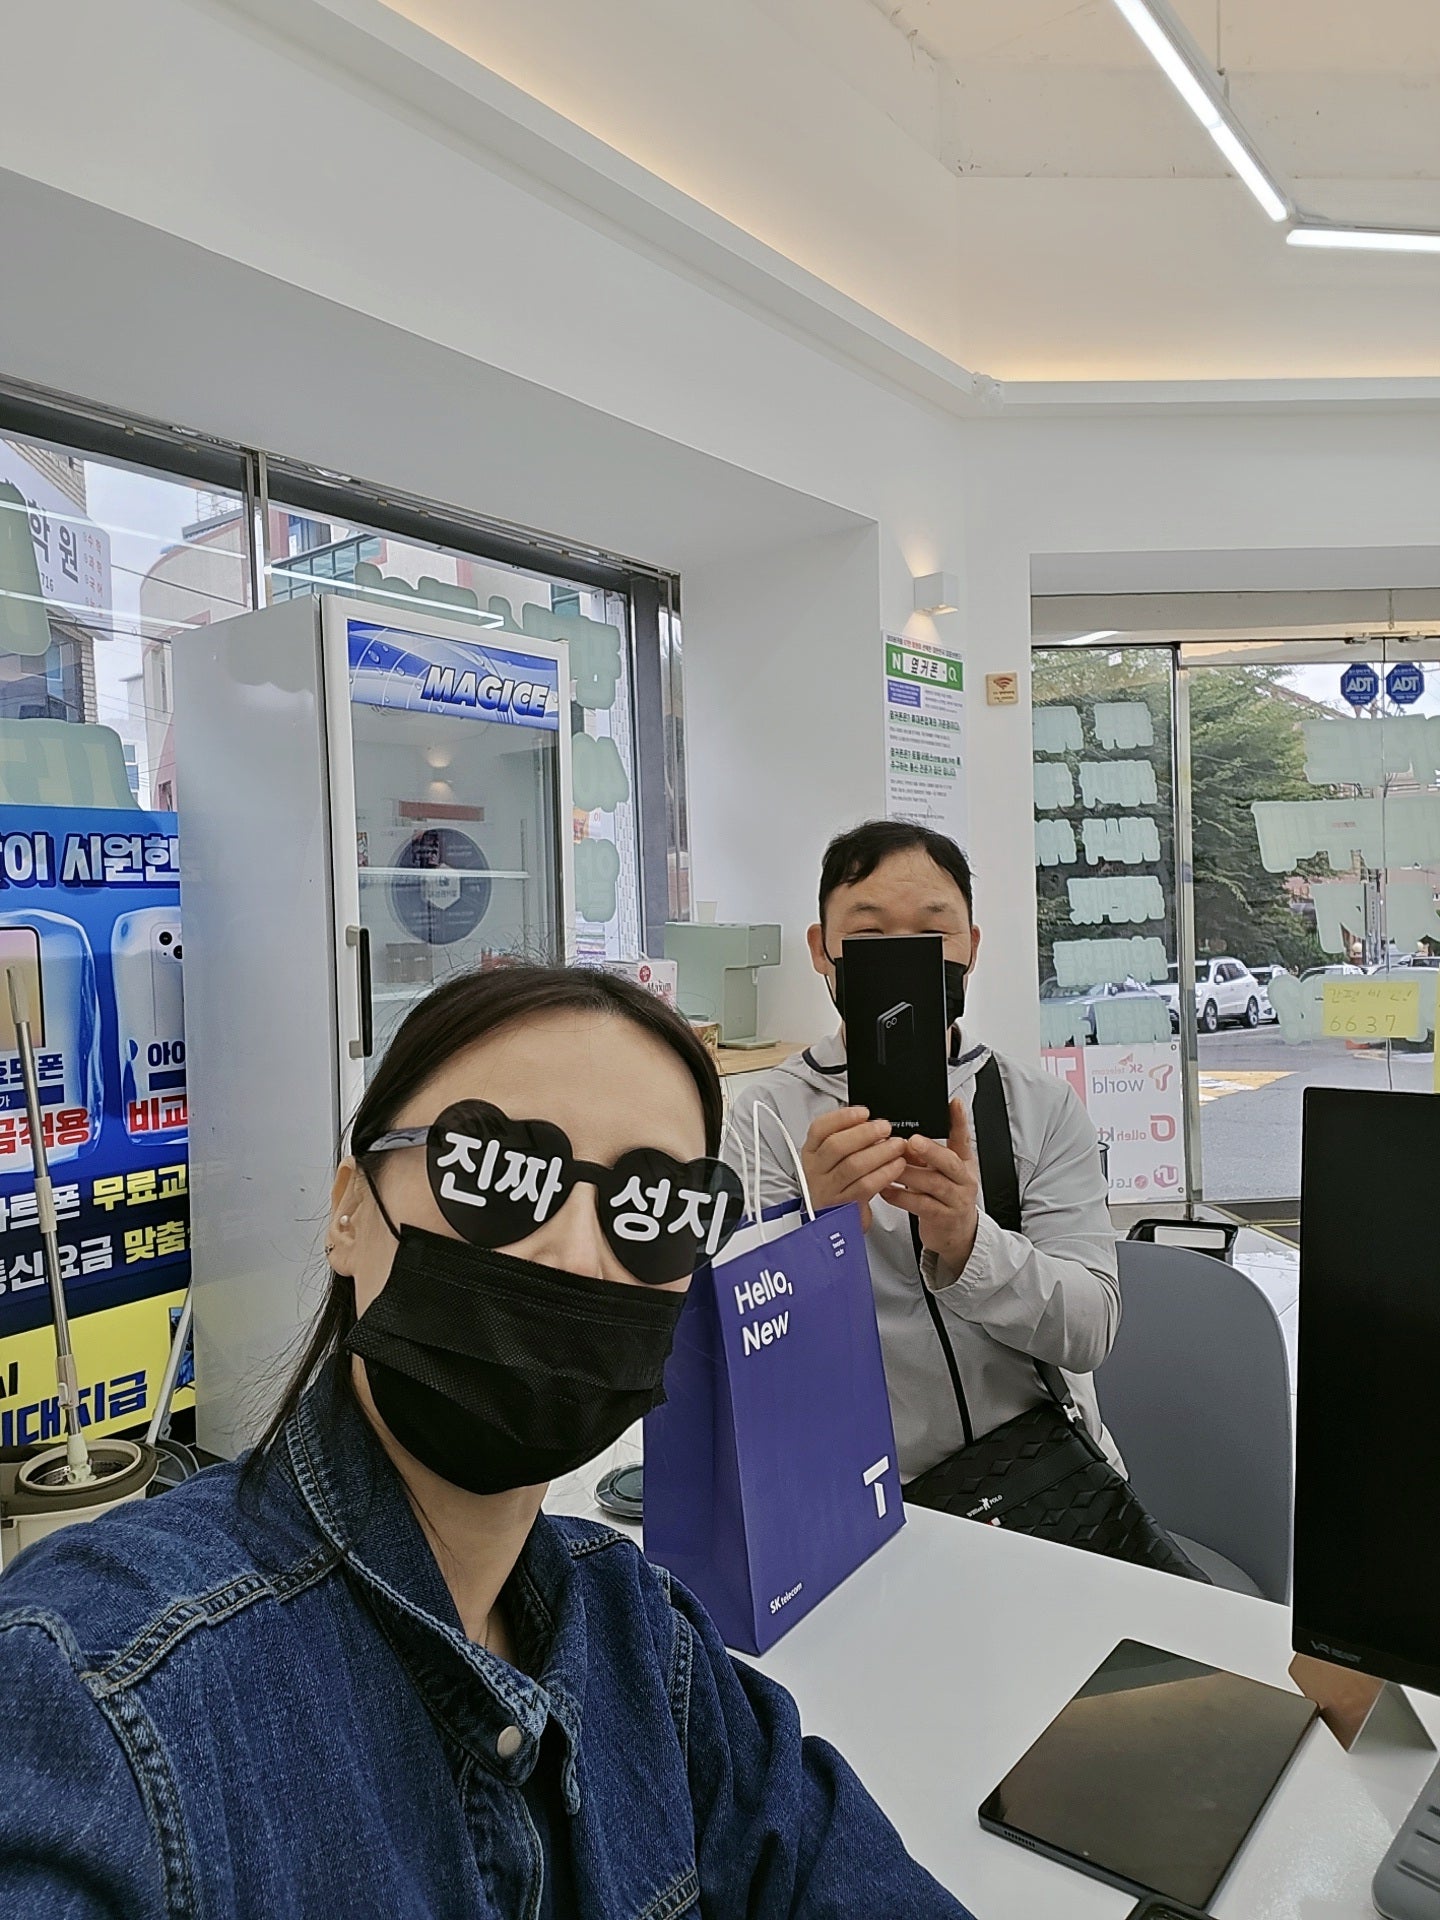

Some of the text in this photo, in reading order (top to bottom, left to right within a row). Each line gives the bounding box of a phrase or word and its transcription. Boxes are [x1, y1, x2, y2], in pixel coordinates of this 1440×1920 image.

[420, 665, 550, 718] MAGICE
[1346, 677, 1374, 692] ADT
[1391, 677, 1419, 692] ADT
[0, 834, 180, 882] 이 시원한
[1330, 1014, 1396, 1033] 6637
[437, 1132, 729, 1255] 진짜 성지
[0, 1220, 190, 1295] 신요금 맞춤
[734, 1269, 793, 1315] Hello,
[742, 1310, 789, 1357] New
[770, 1582, 802, 1614] SK telecom
